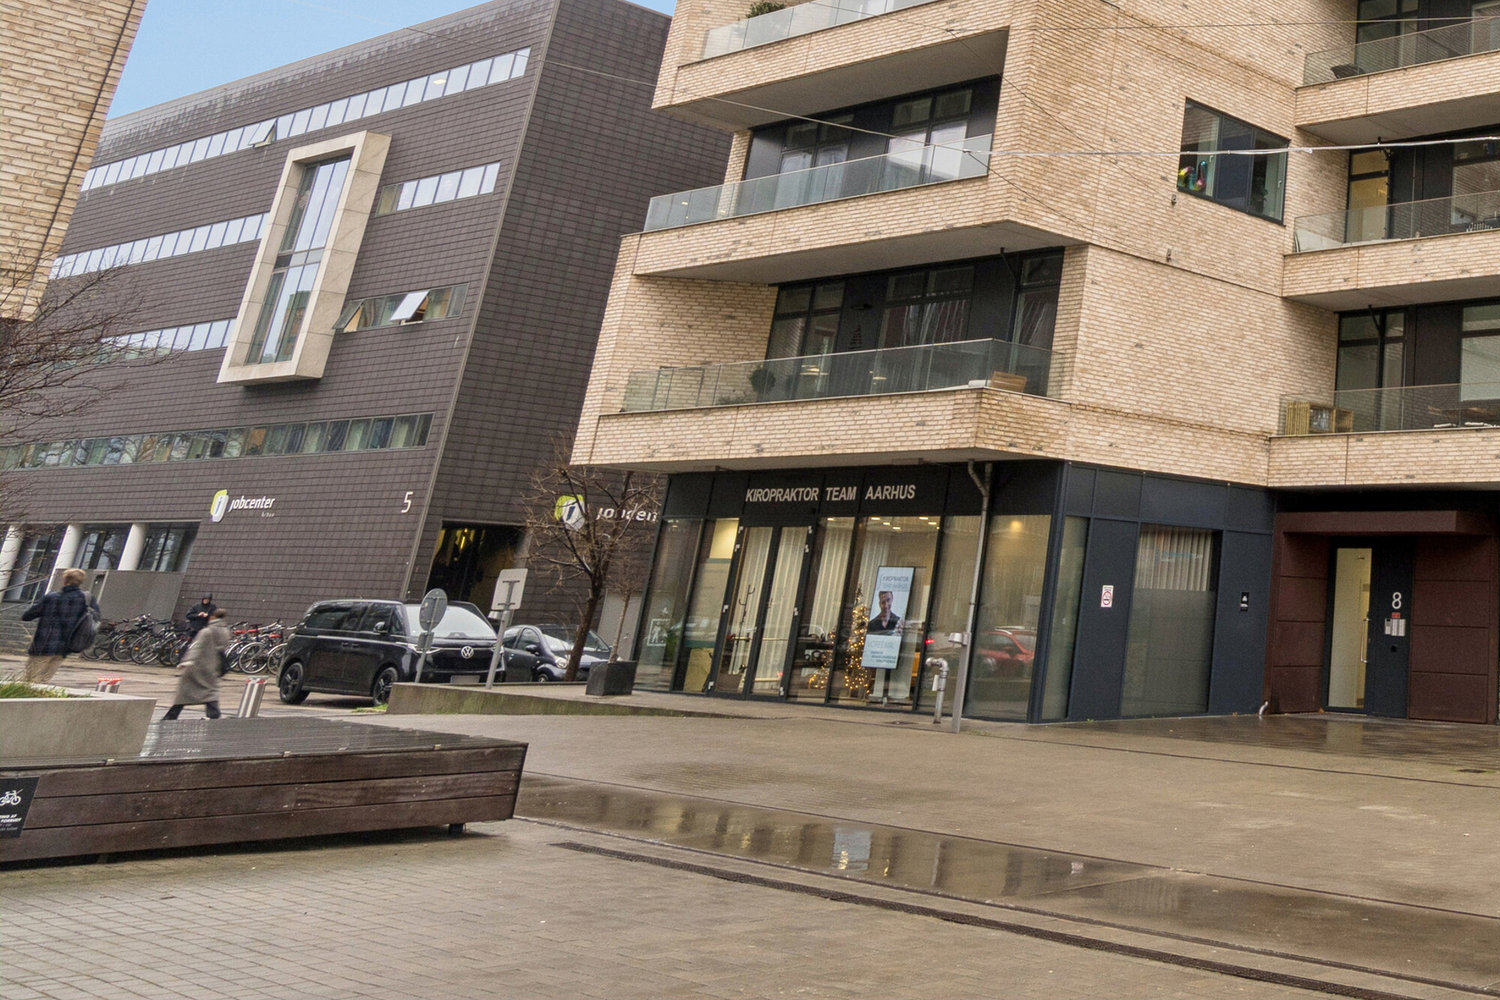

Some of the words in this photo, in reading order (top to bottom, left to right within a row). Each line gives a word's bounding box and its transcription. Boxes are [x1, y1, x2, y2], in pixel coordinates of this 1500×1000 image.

[401, 491, 414, 513] 5
[745, 487, 820, 502] KIROPRAKTOR
[826, 486, 857, 501] TEAM
[865, 484, 916, 500] AARHUS
[228, 495, 276, 513] jobcenter
[1391, 591, 1402, 610] 8
